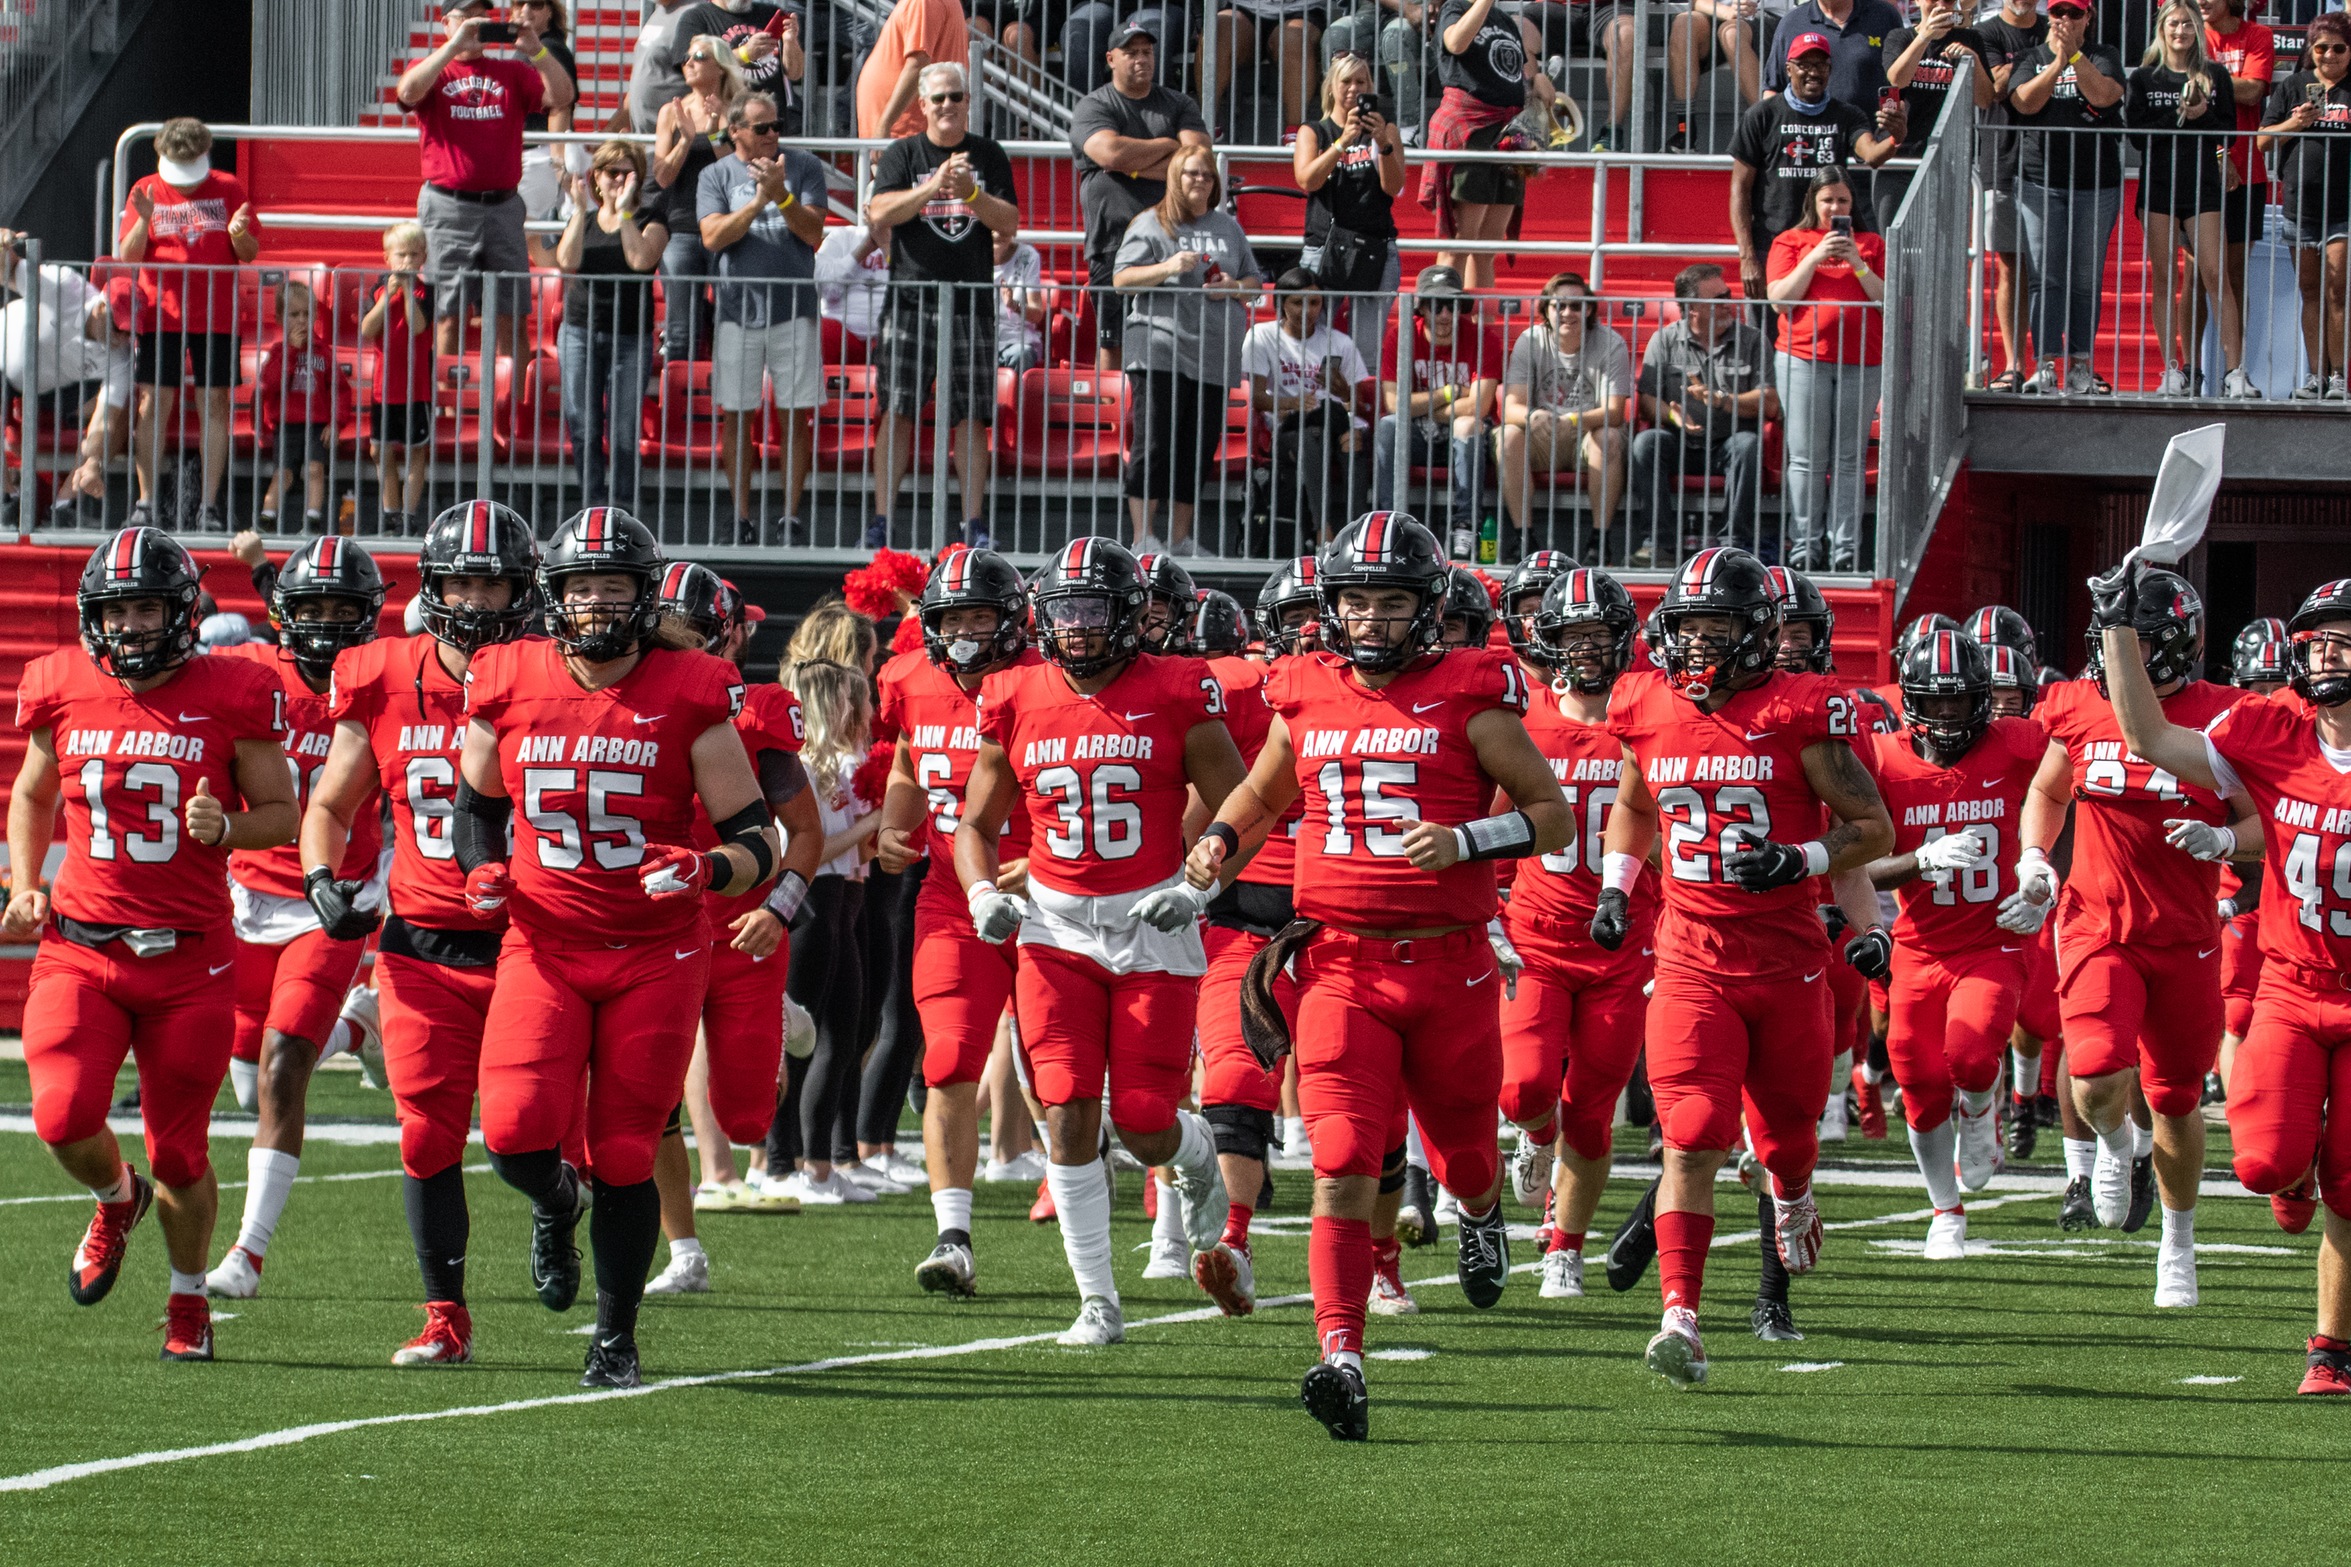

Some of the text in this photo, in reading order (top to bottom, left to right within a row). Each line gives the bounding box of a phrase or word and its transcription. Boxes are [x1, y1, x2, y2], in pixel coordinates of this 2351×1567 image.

[442, 75, 504, 97] CONCORDIA
[1912, 81, 1952, 90] OOTBALL
[450, 104, 504, 120] FOOTBALL
[1780, 123, 1839, 135] CONCORDIA
[1818, 137, 1833, 150] 19
[1778, 167, 1818, 178] UNIVER
[152, 205, 227, 226] CHAMPIONS
[1178, 236, 1229, 253] CUAA
[466, 555, 491, 563] Riddell
[107, 581, 138, 589] COMPELLED
[1937, 676, 1957, 684] Riddell
[65, 729, 205, 762] ANN ARBOR
[397, 725, 445, 751] ANN
[912, 725, 946, 749] ANN
[1301, 727, 1440, 758] ANN ARBOR
[515, 735, 659, 768] ANN ARBOR
[1023, 734, 1153, 768] ANN ARBOR
[2083, 741, 2122, 761] ANN
[1571, 758, 1624, 781] ARBO
[1647, 755, 1774, 782] ANN ARBOR
[918, 752, 960, 835] 6
[79, 758, 180, 863] 13
[523, 767, 647, 871] 55
[1035, 763, 1143, 861] 36
[1317, 760, 1422, 858] 15
[1903, 798, 2005, 826] ANN ARBOR
[2273, 797, 2319, 829] ANN
[1656, 785, 1772, 884] 22
[1920, 823, 2000, 906] 48
